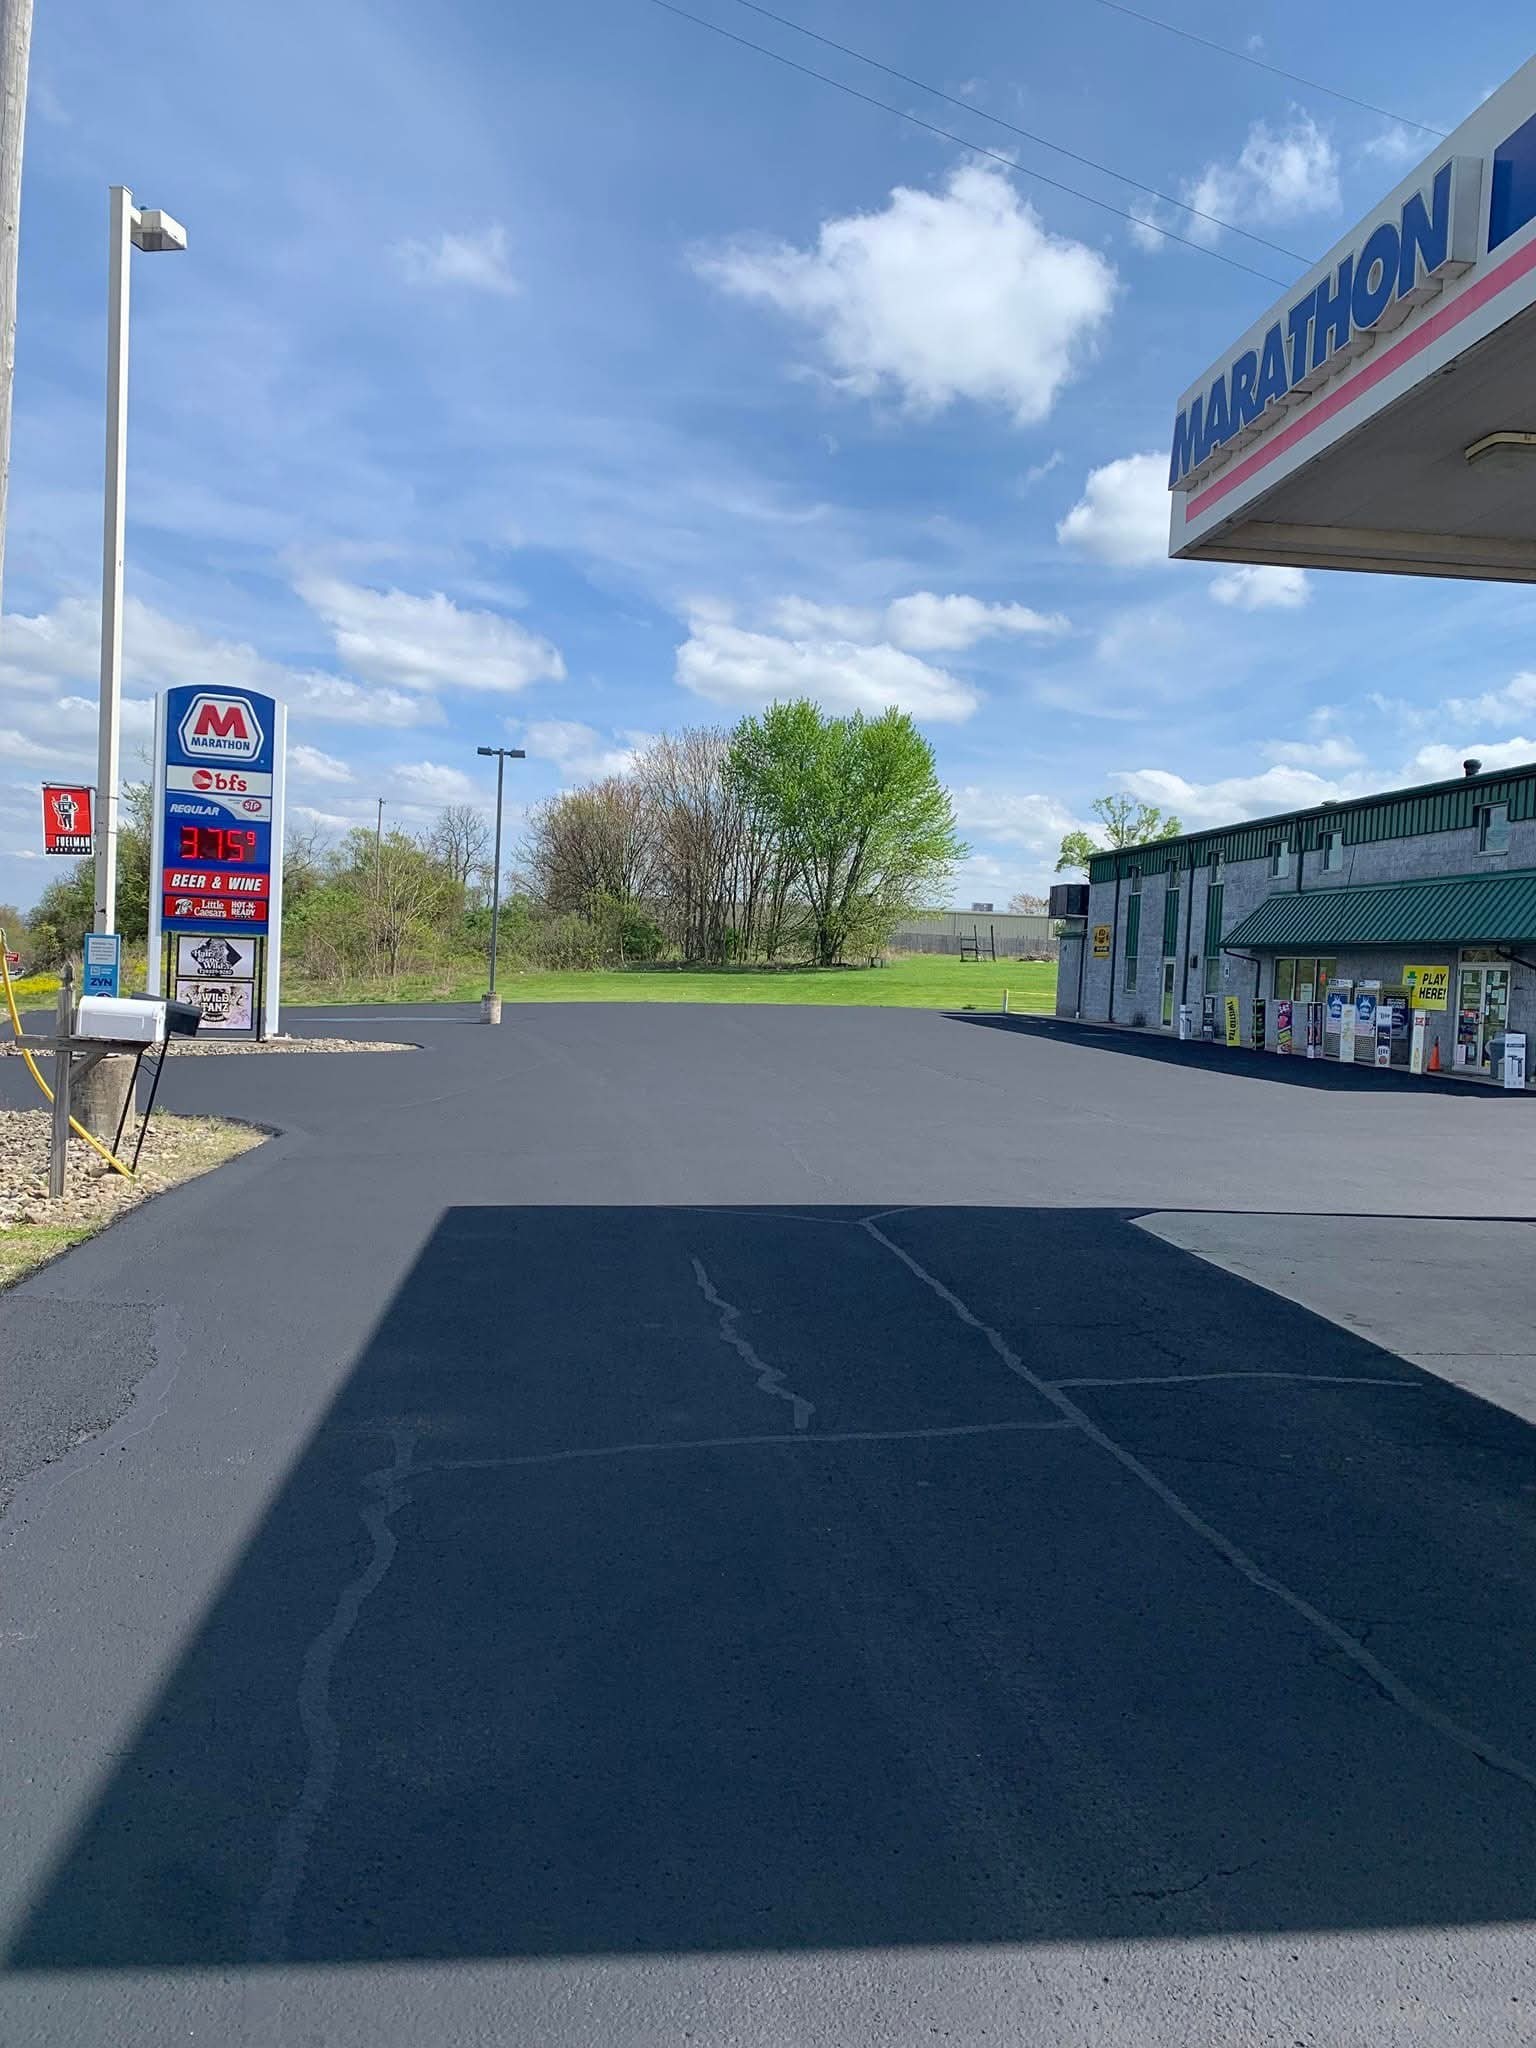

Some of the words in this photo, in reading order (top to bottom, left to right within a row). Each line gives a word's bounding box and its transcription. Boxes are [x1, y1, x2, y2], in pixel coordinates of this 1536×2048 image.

[1168, 157, 1452, 490] MARATHON
[194, 704, 248, 738] M
[191, 737, 250, 750] MARATHON
[214, 773, 247, 792] bfs
[170, 803, 220, 816] REGULAR
[244, 801, 260, 811] STP
[56, 836, 91, 847] FUELMAN
[171, 874, 206, 888] BEER
[211, 876, 222, 889] &
[228, 877, 263, 891] WINE
[201, 899, 225, 909] Little
[194, 907, 227, 917] Caesars
[89, 977, 113, 987] ZYN
[1422, 973, 1446, 986] PLAY
[201, 993, 229, 1002] WILD
[1419, 987, 1447, 1000] HERE!
[200, 1002, 229, 1012] TANZ
